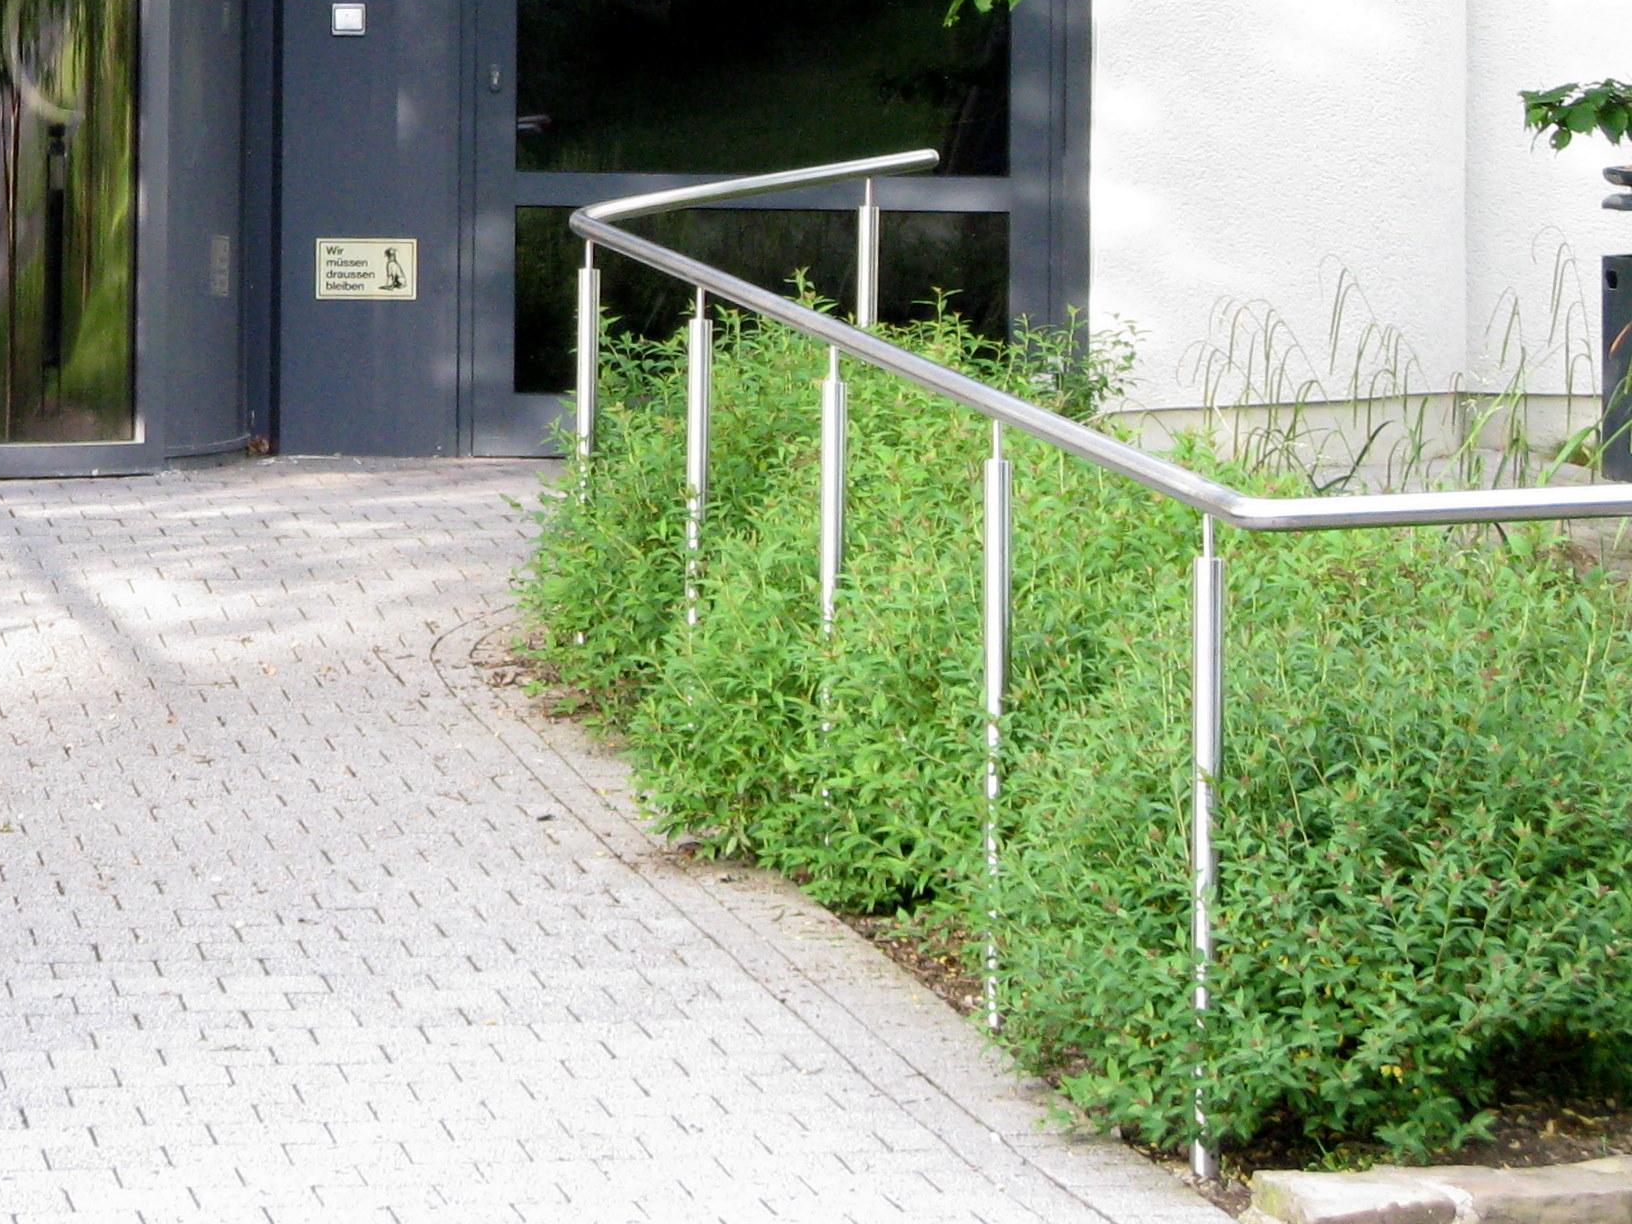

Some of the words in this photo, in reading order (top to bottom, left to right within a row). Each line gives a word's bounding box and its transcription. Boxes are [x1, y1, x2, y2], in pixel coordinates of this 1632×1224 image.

[326, 246, 344, 255] Wir
[326, 258, 369, 267] müssen
[326, 270, 376, 279] draussen
[326, 281, 365, 291] bleiben
